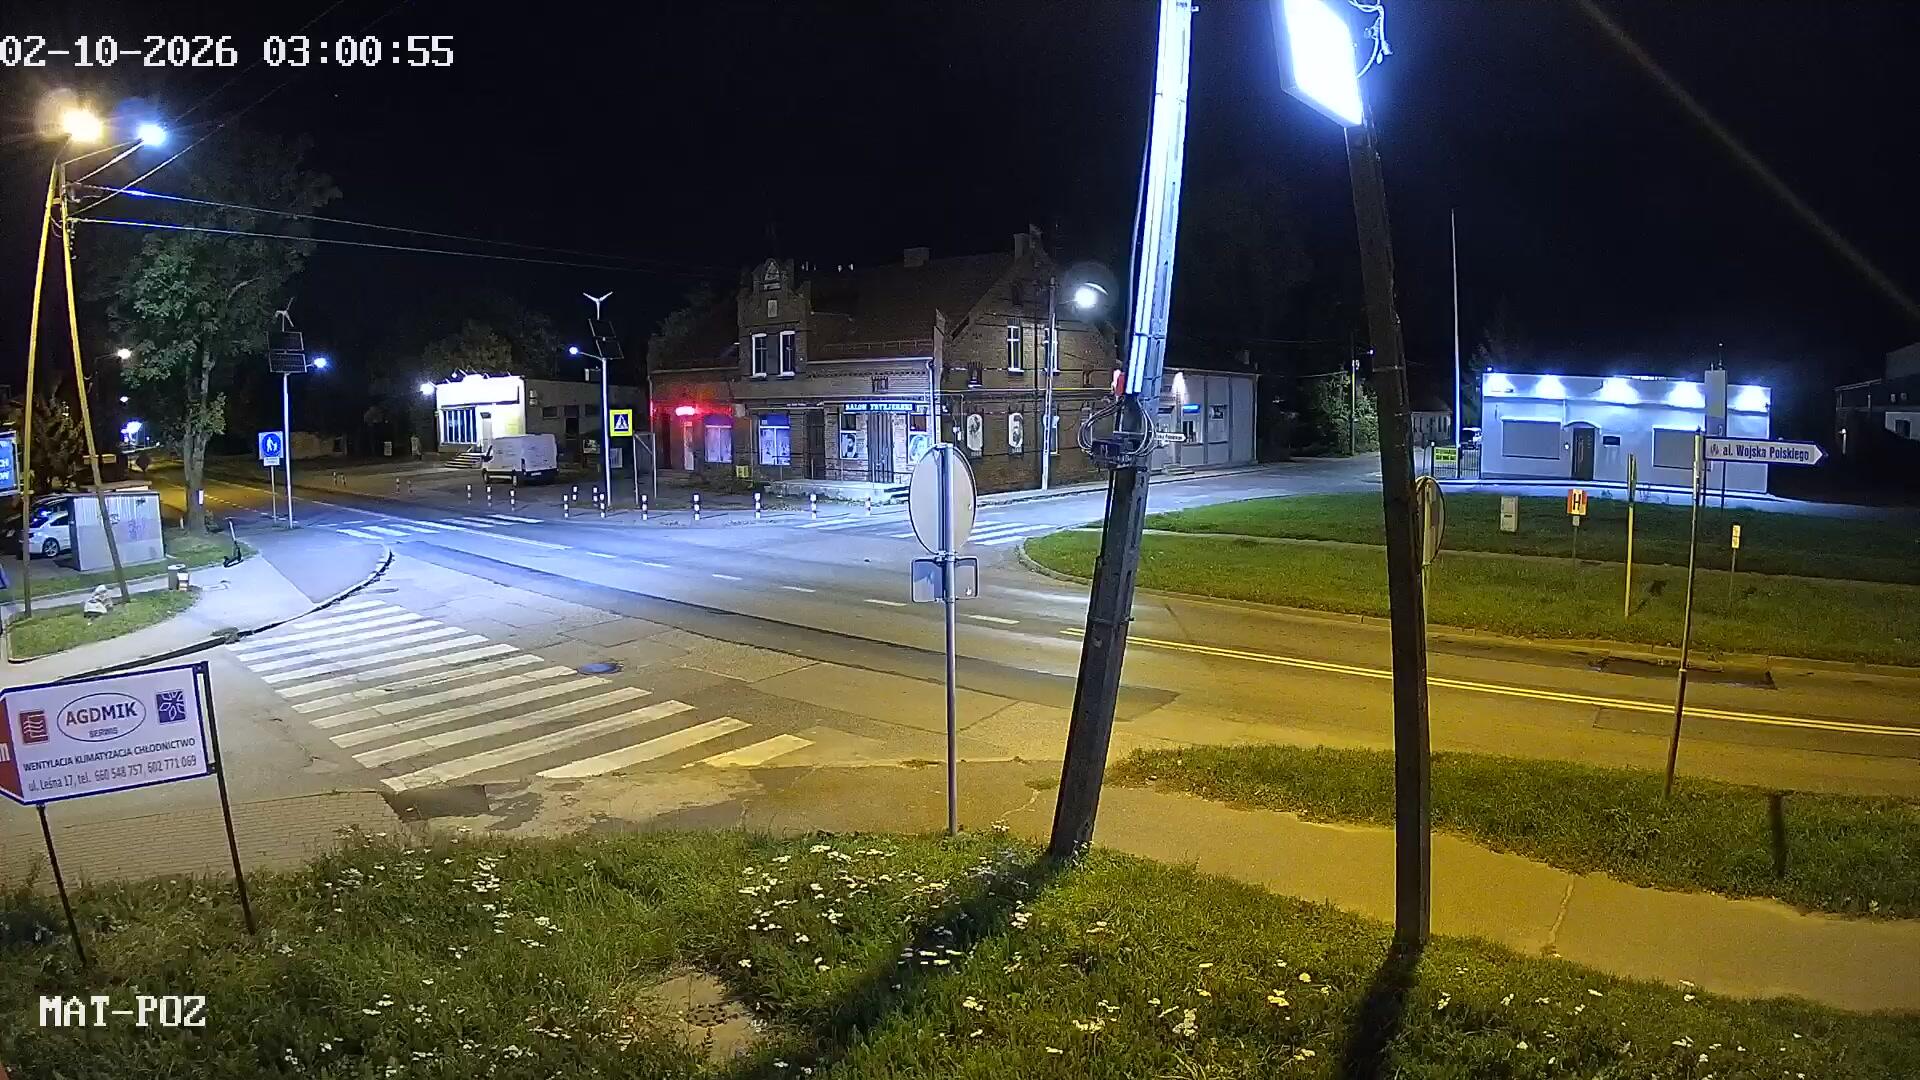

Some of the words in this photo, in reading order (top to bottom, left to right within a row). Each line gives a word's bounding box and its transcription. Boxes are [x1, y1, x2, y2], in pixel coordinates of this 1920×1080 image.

[1722, 443, 1734, 456] al.
[1736, 444, 1767, 459] Wojska
[1769, 446, 1809, 462] Polskiego
[1573, 493, 1582, 510] H
[66, 702, 138, 726] AGDMIK
[23, 757, 74, 772] WENTYLACJA
[75, 748, 132, 764] KLIMATYZACJA
